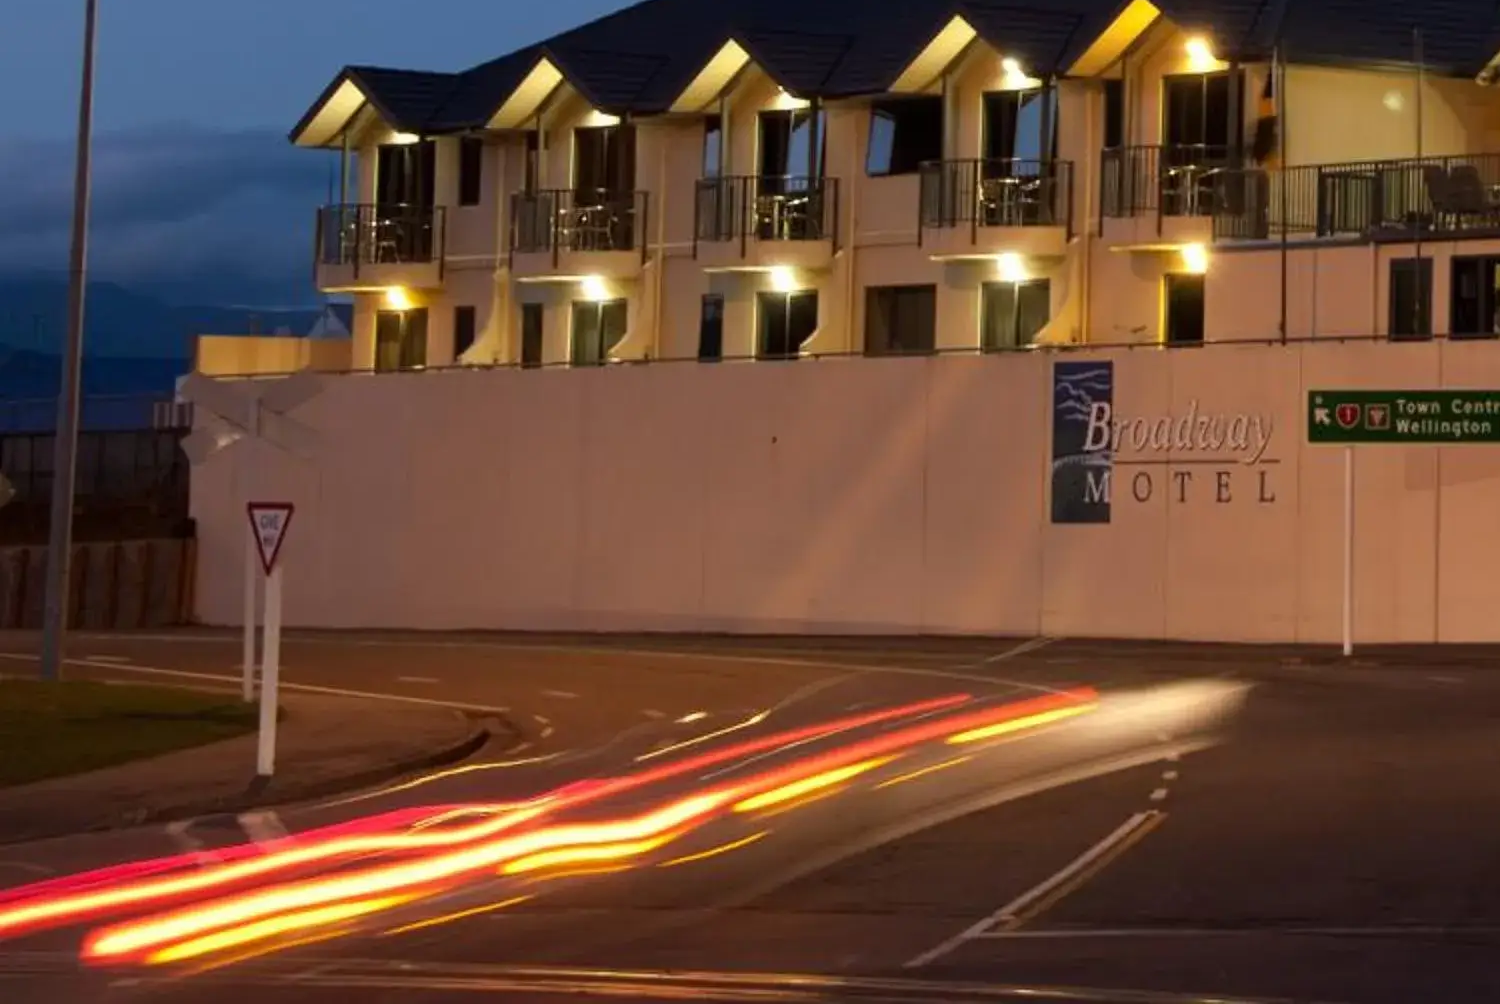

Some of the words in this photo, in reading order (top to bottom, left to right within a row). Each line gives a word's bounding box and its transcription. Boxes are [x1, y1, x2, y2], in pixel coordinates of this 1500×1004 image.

[1396, 399, 1441, 414] Town
[1083, 399, 1274, 465] Broadway
[1396, 418, 1492, 437] Wellington
[1083, 470, 1276, 503] MOTEL
